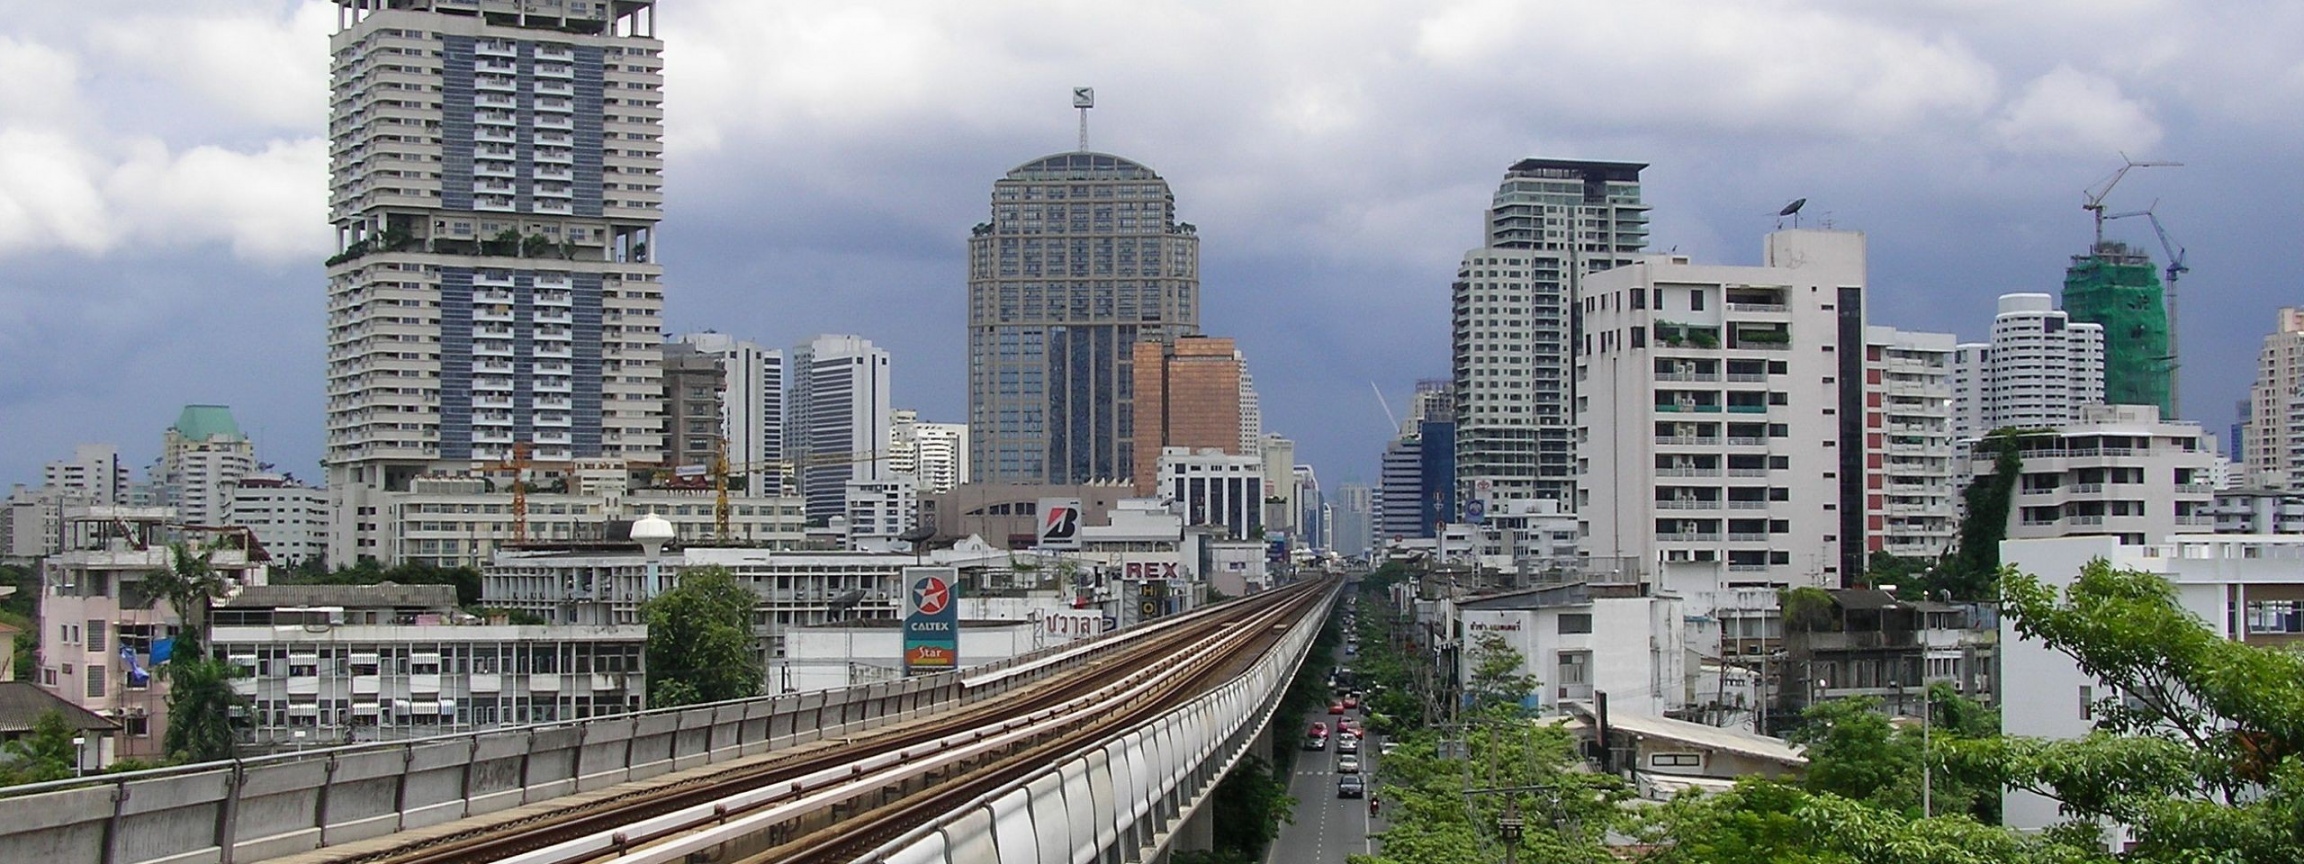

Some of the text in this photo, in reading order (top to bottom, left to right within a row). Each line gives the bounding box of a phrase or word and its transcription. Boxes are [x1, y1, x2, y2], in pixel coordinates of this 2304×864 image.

[1126, 562, 1178, 578] REX
[911, 622, 949, 631] CALTEX
[919, 646, 942, 659] Star
